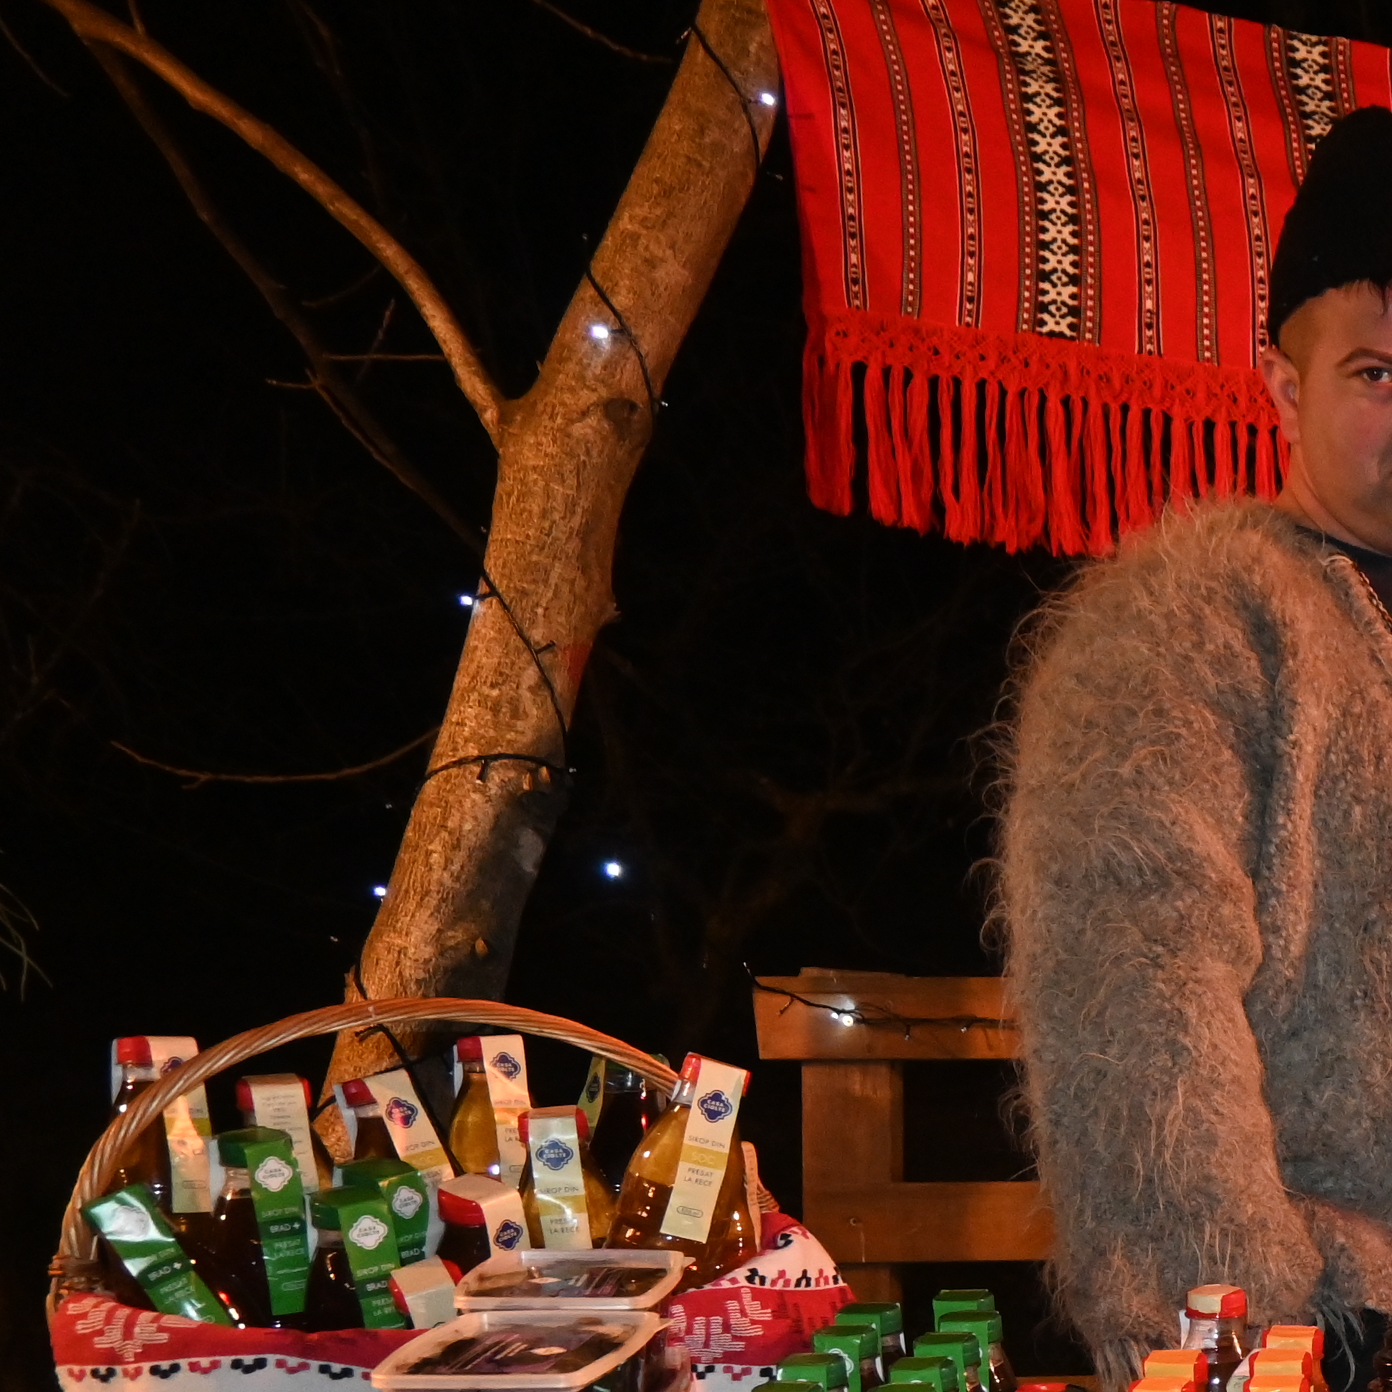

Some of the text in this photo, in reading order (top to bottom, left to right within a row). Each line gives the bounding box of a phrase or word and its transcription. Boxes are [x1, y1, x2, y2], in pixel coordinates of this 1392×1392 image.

[688, 1135, 710, 1144] SIROP
[691, 1153, 716, 1165] SOC
[688, 1168, 714, 1178] PRESAT
[694, 1178, 713, 1187] RECE
[270, 1224, 290, 1233] BRAD
